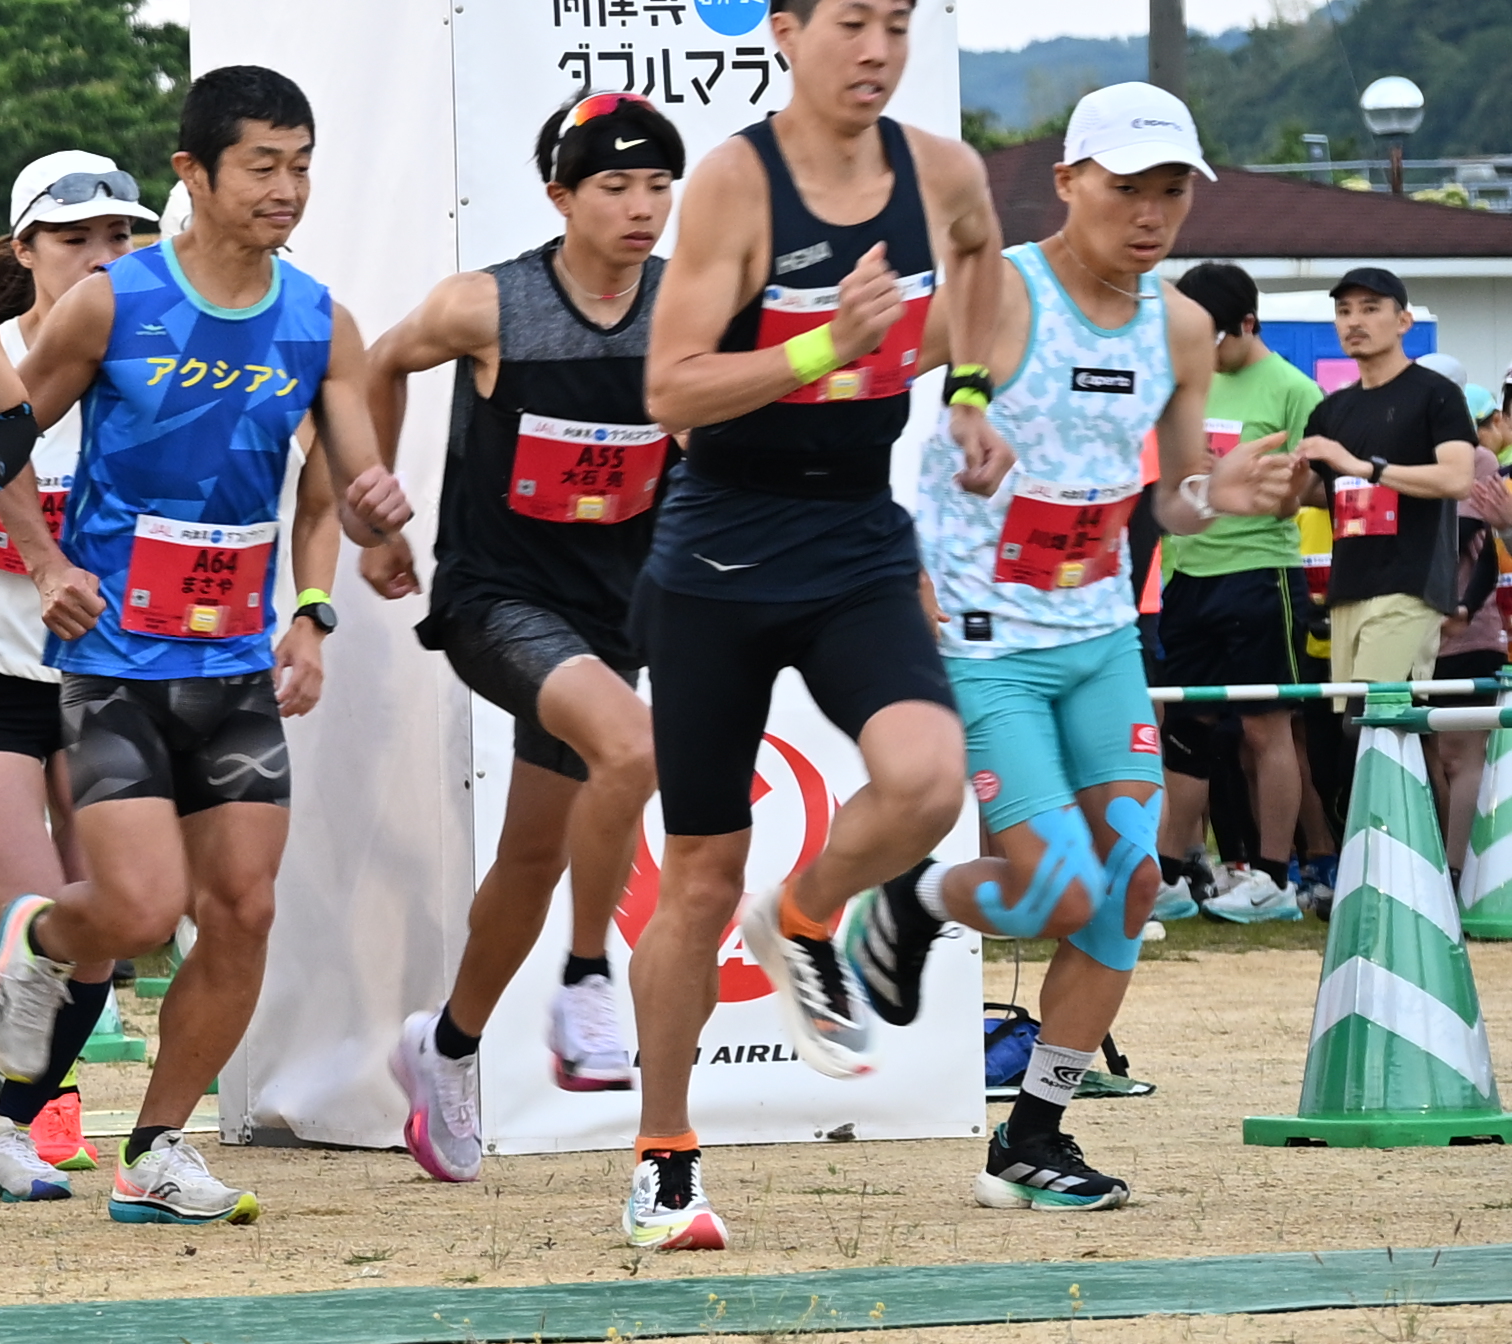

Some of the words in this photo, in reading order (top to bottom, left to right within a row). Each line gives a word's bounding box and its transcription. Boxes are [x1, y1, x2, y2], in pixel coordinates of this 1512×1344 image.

[146, 357, 299, 397] アクシアン
[192, 549, 239, 574] A64
[181, 577, 234, 596] まさや
[710, 1043, 799, 1065] AIRLI
